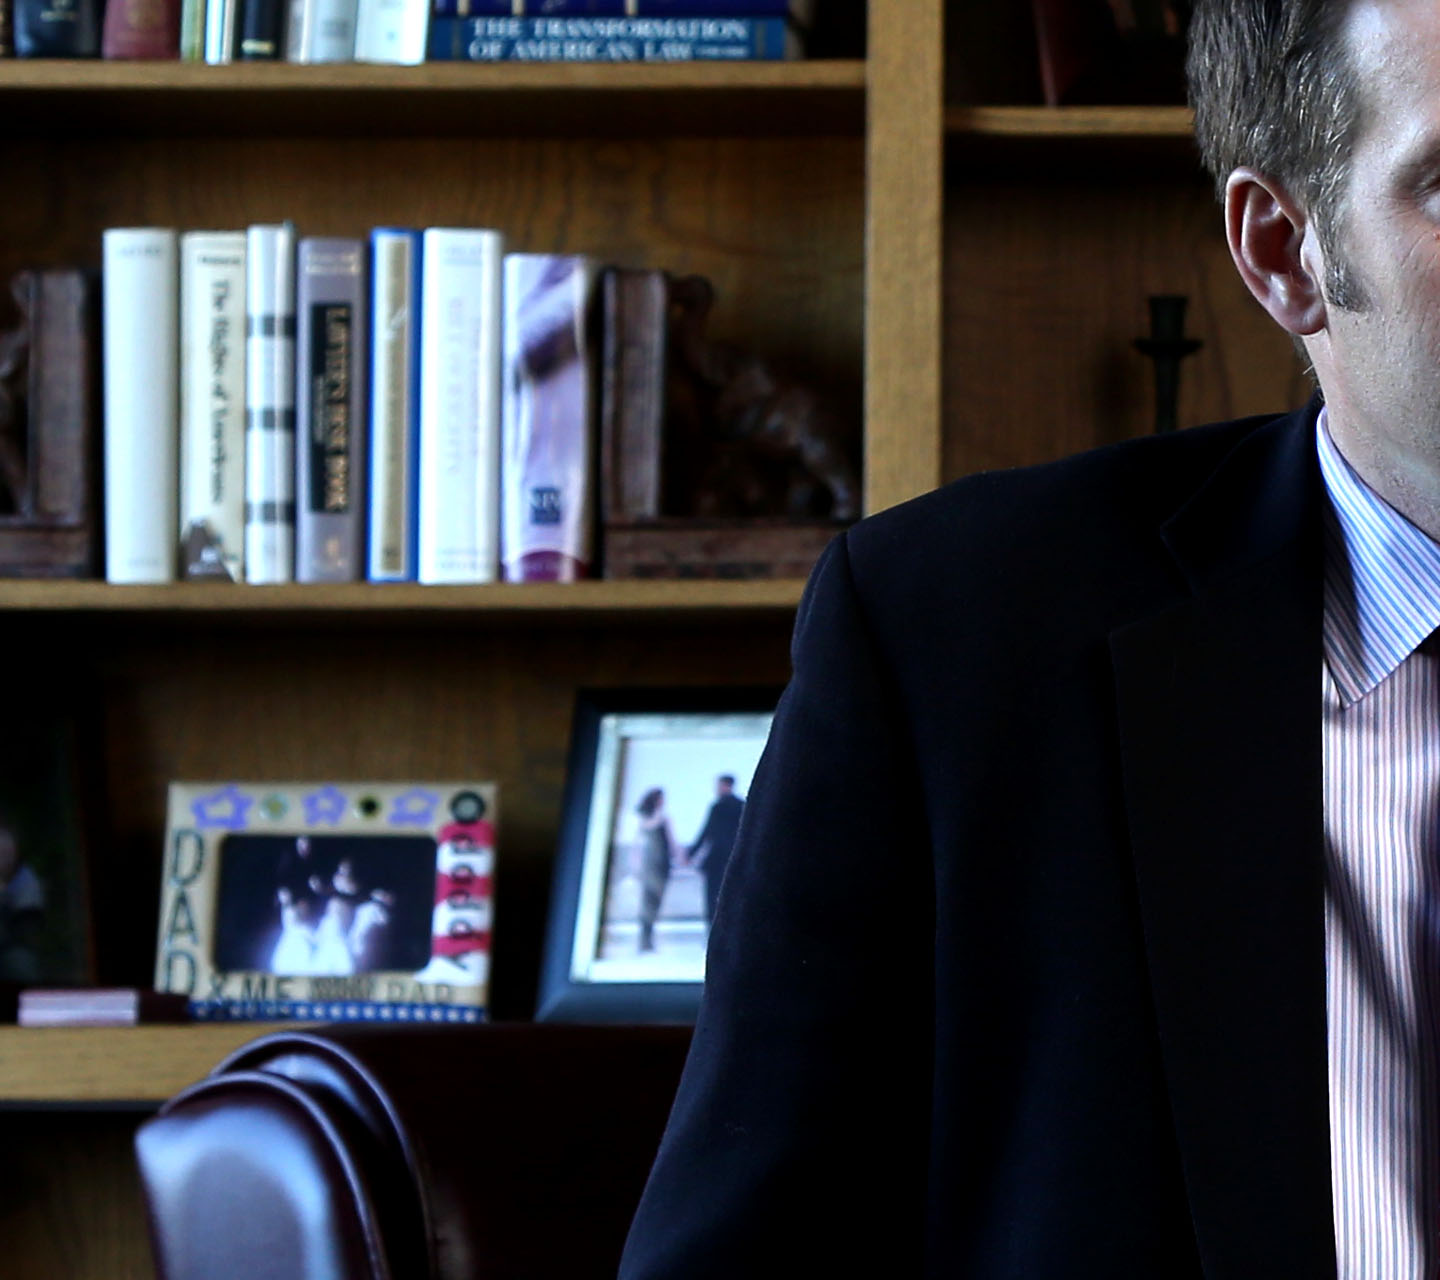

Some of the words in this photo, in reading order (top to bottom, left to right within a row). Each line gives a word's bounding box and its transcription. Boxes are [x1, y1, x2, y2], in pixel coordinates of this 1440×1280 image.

[474, 18, 522, 38] THE
[533, 18, 747, 39] TRANSFORMATION
[468, 41, 502, 60] OF
[509, 41, 637, 61] AMERICAN
[643, 41, 692, 61] LAW
[214, 278, 229, 312] The
[208, 316, 231, 376] Rights
[214, 382, 231, 400] of
[325, 454, 350, 510] BOOK
